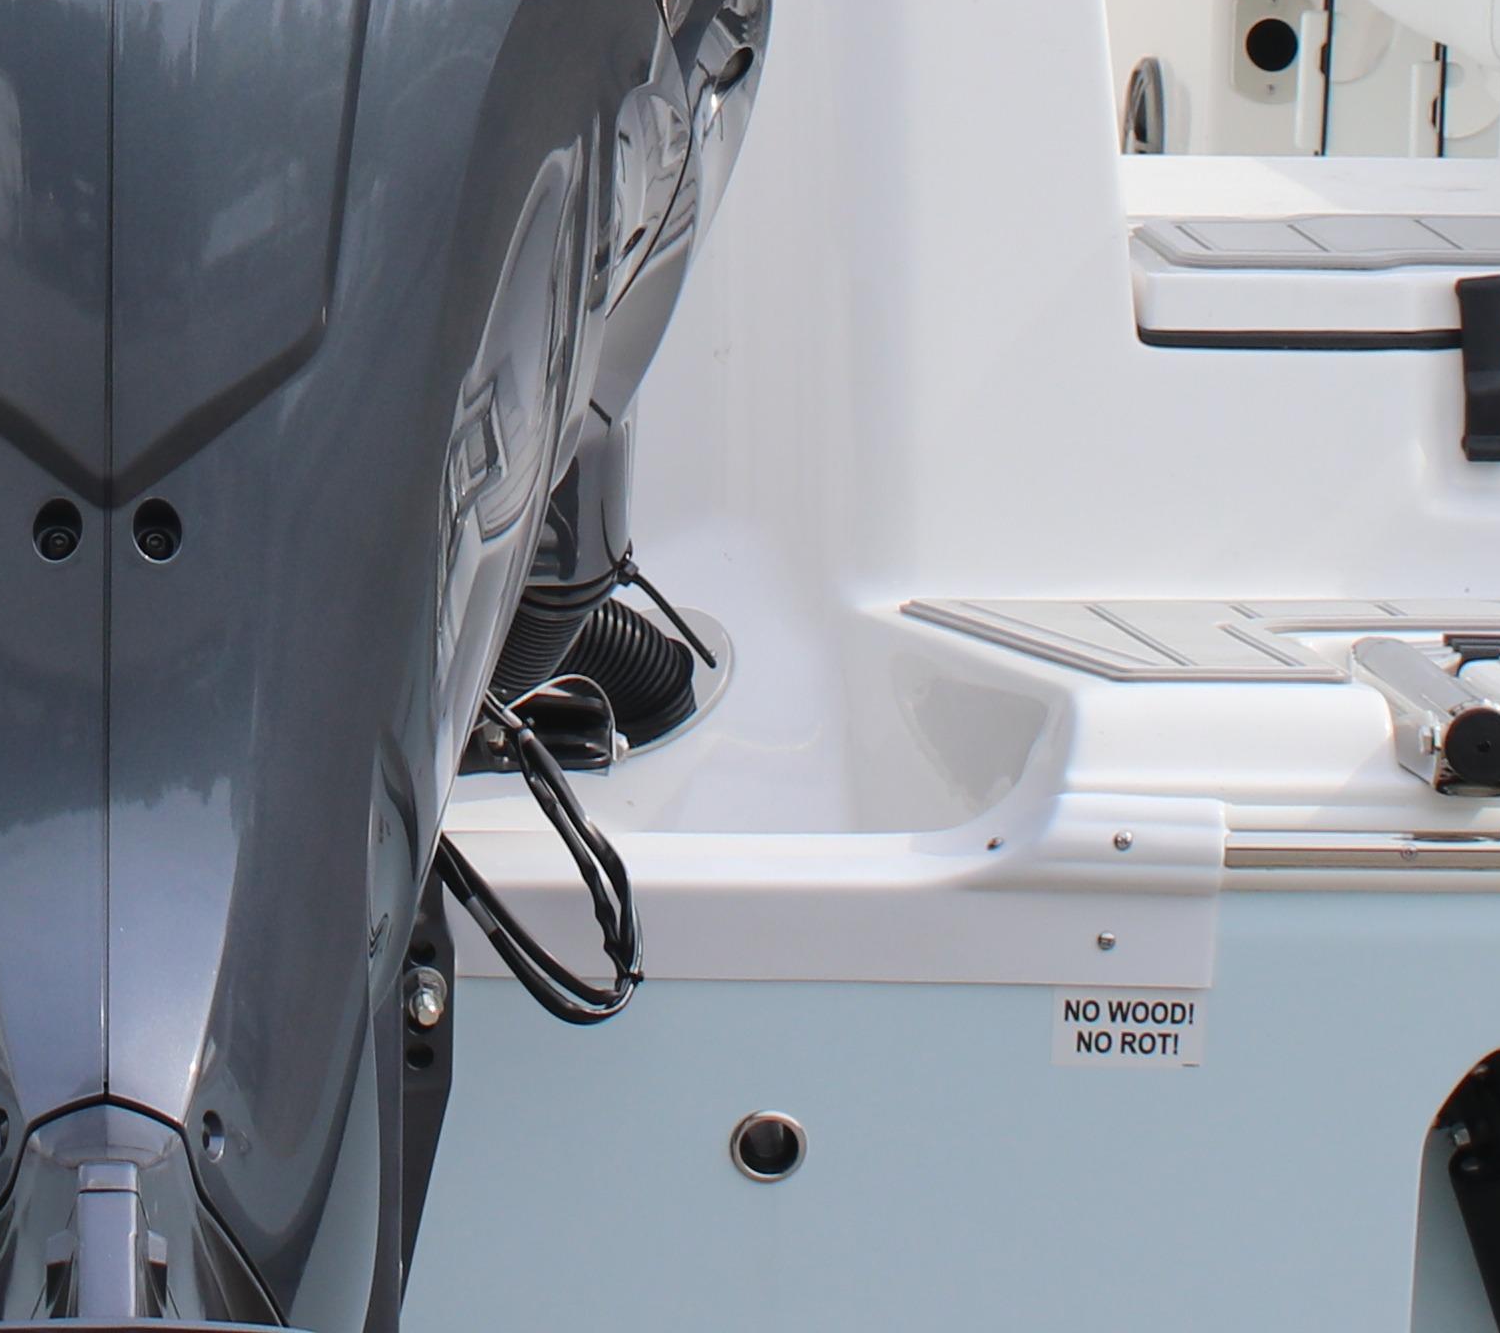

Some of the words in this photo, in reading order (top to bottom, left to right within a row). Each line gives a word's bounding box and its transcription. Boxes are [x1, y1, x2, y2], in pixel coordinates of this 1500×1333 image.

[1064, 999, 1100, 1023] NO
[1108, 1001, 1194, 1025] WOOD!
[1076, 1031, 1112, 1053] NO
[1120, 1032, 1178, 1055] ROT!
